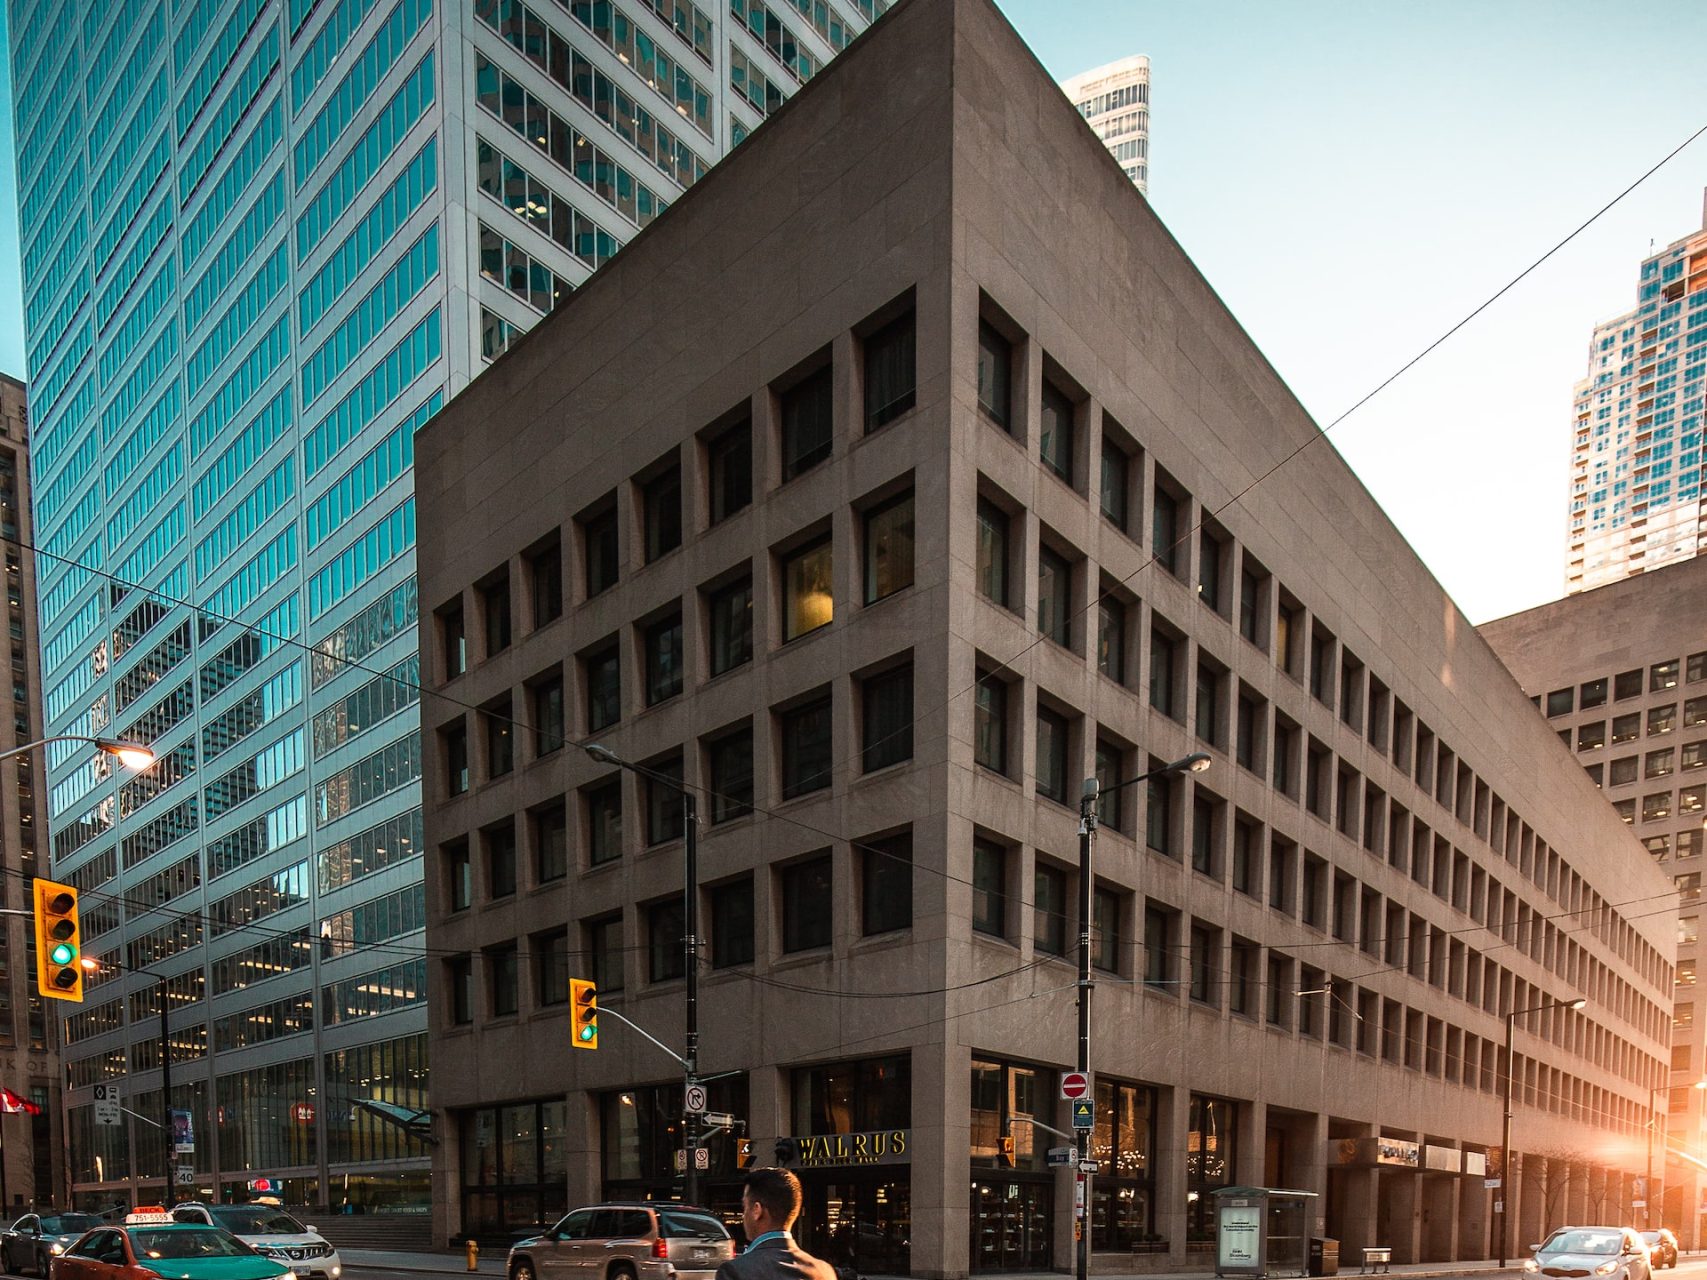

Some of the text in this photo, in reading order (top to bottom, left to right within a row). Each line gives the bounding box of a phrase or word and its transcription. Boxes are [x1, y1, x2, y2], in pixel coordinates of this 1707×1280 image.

[26, 1060, 47, 1072] OF
[798, 1131, 905, 1160] WALRUS
[180, 1173, 193, 1182] 40
